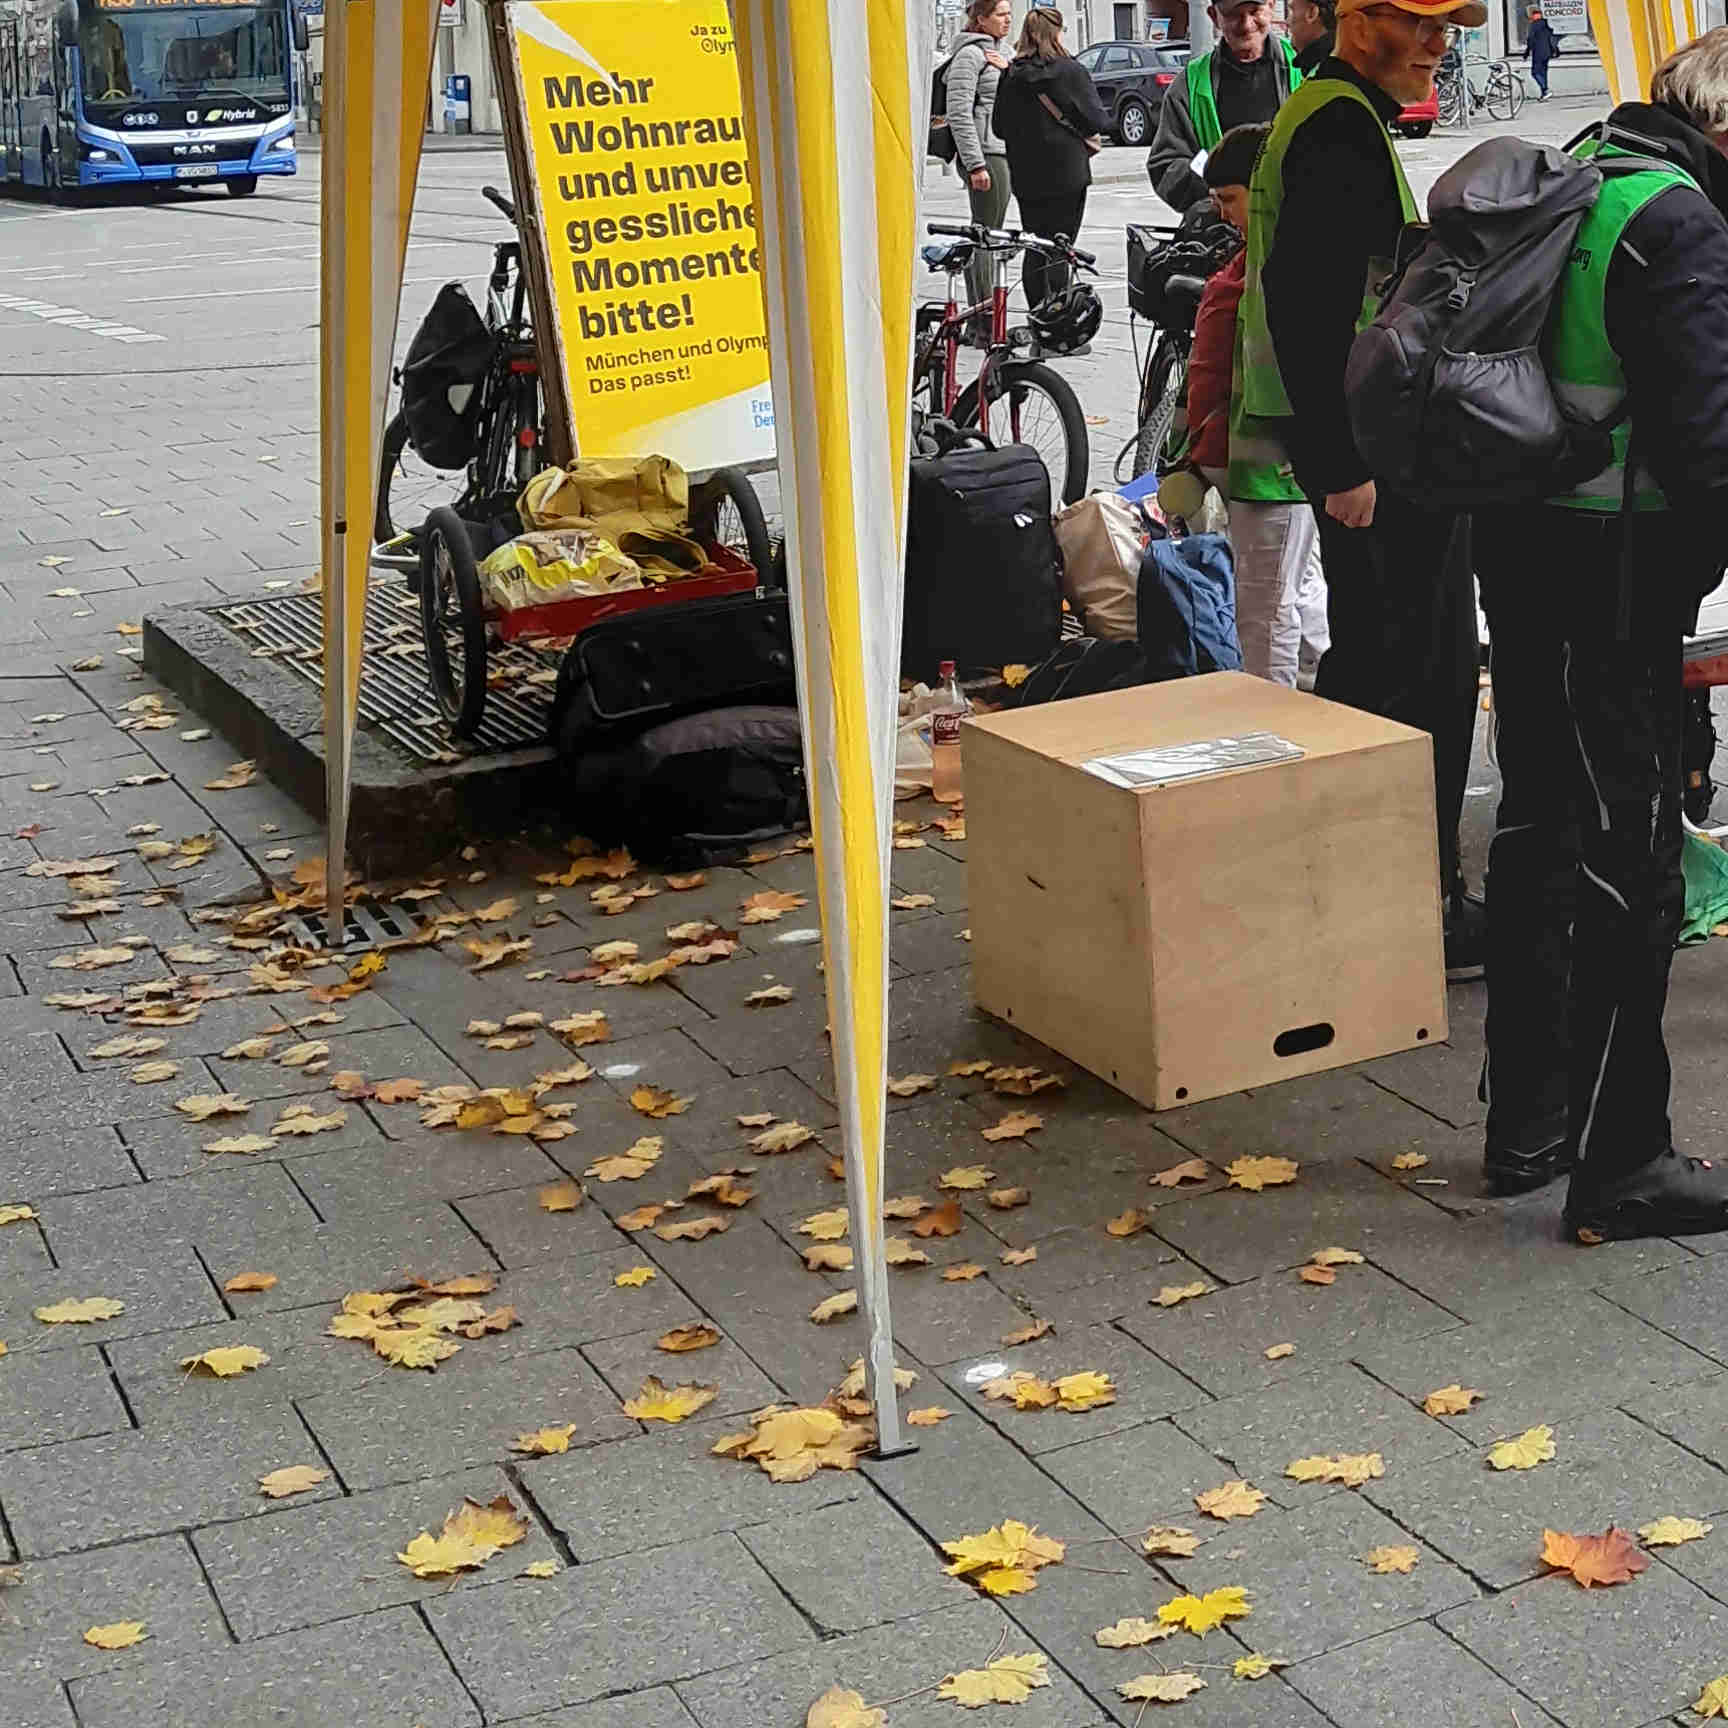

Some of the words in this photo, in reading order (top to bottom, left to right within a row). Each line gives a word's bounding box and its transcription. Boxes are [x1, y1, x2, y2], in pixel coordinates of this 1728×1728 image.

[690, 25, 708, 36] Ja
[711, 25, 727, 36] zu
[543, 72, 654, 109] Mehr
[222, 108, 256, 122] Hybrid
[173, 144, 216, 156] MAN
[549, 115, 745, 155] Wohnrau
[558, 161, 638, 201] und
[578, 293, 695, 340] bitte!
[585, 347, 675, 372] München
[678, 340, 713, 359] und
[589, 376, 626, 394] Das
[630, 364, 692, 392] passt!
